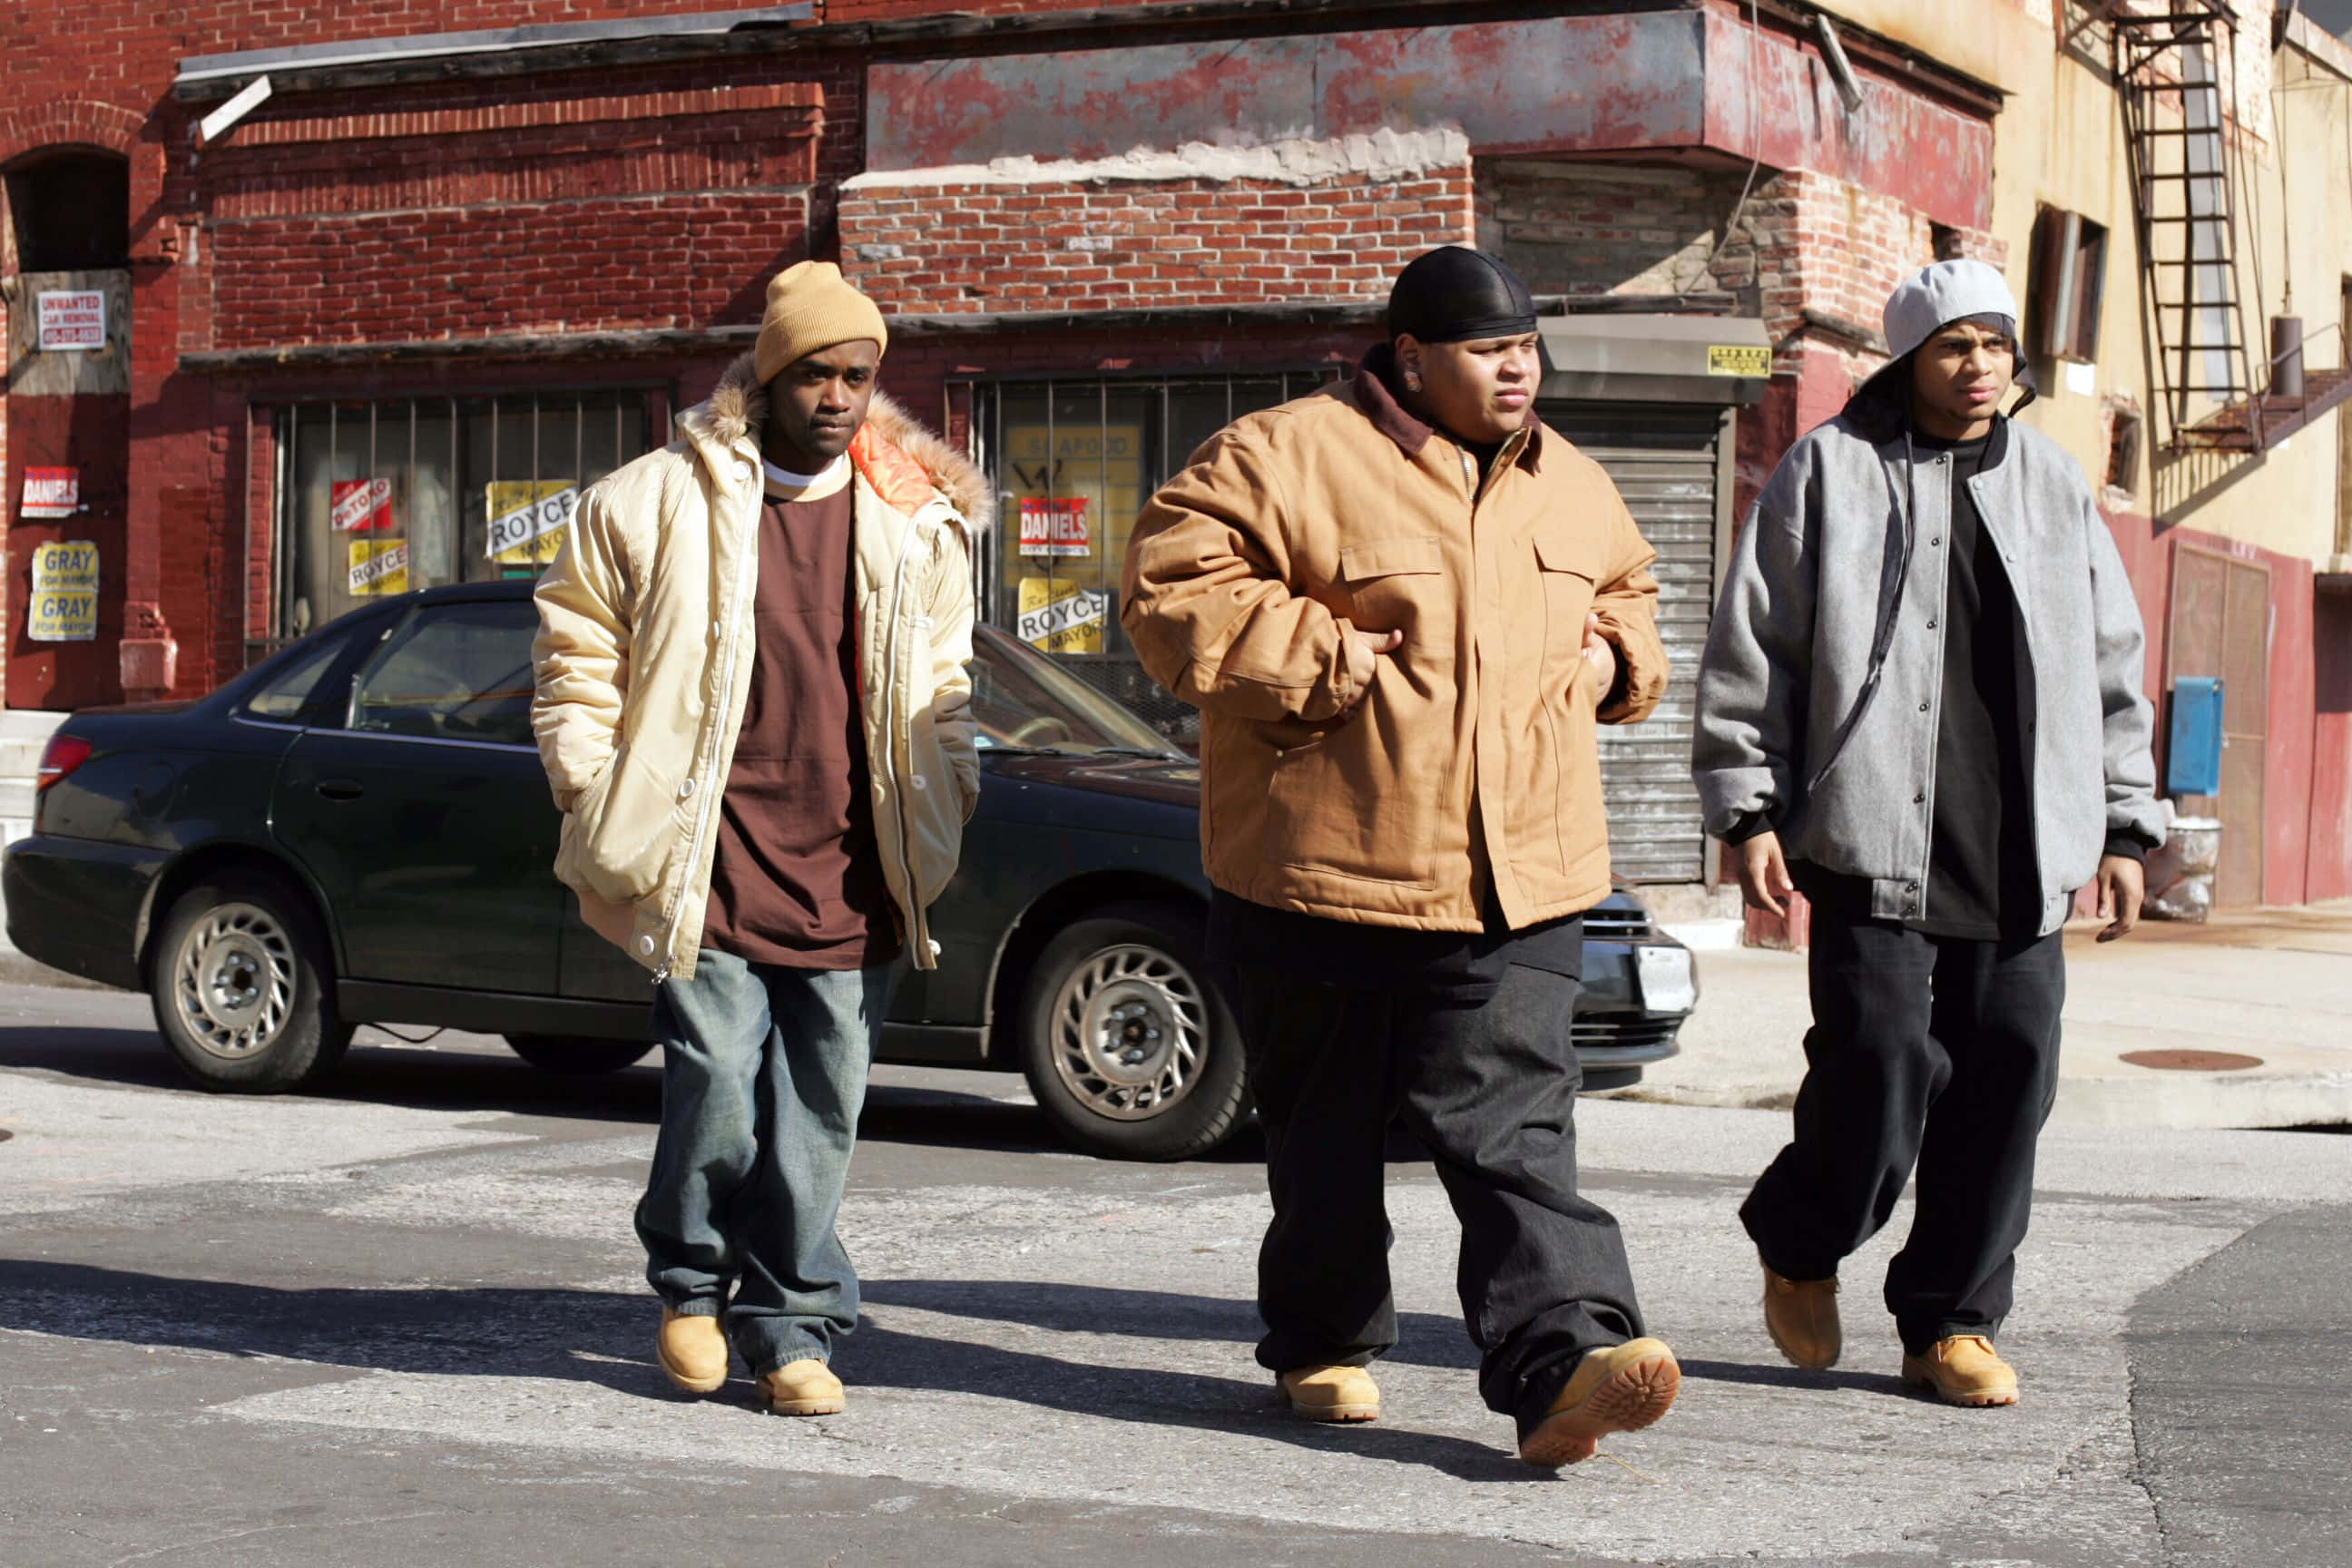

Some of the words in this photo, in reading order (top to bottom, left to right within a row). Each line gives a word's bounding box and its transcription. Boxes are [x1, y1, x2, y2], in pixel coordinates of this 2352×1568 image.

[43, 296, 100, 310] UNWANTED
[23, 479, 78, 504] DANIELS
[491, 493, 573, 548] ROYCE
[1021, 512, 1088, 540] DANIELS
[520, 528, 566, 558] MAYO
[44, 550, 93, 570] GRAY
[351, 548, 407, 584] ROYCE
[42, 596, 92, 617] GRAY
[1022, 597, 1105, 637] ROYCE
[1051, 620, 1104, 650] MAYOR
